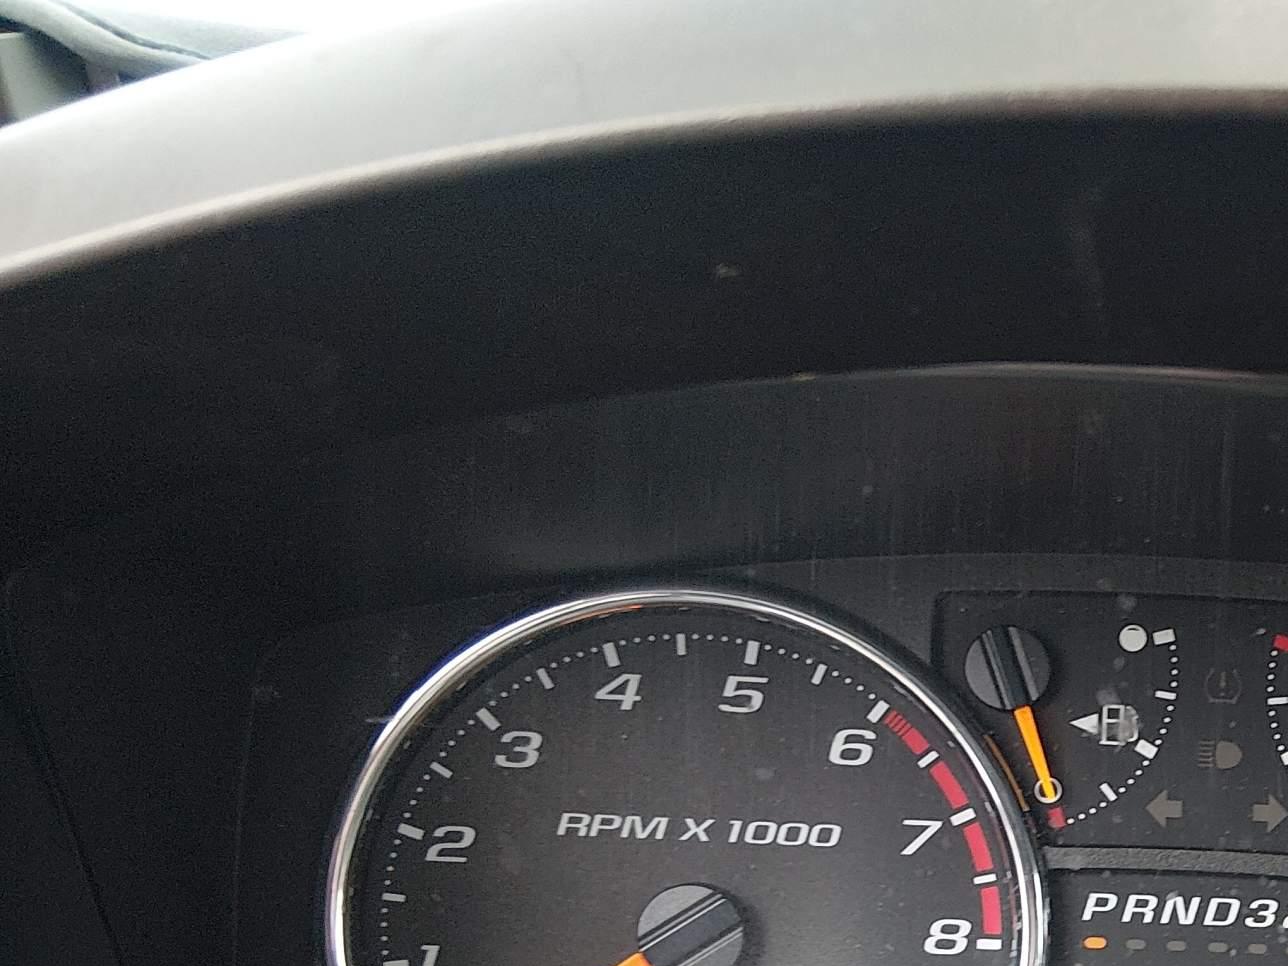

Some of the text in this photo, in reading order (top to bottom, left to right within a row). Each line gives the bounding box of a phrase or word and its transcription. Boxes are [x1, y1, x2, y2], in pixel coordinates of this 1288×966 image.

[596, 673, 642, 710] 4
[718, 675, 769, 714] 5
[494, 730, 544, 769] 3
[828, 728, 874, 767] 6
[425, 825, 477, 864] 2
[556, 811, 842, 848] RPM X 1000
[900, 819, 942, 855] 7
[922, 918, 971, 957] 8
